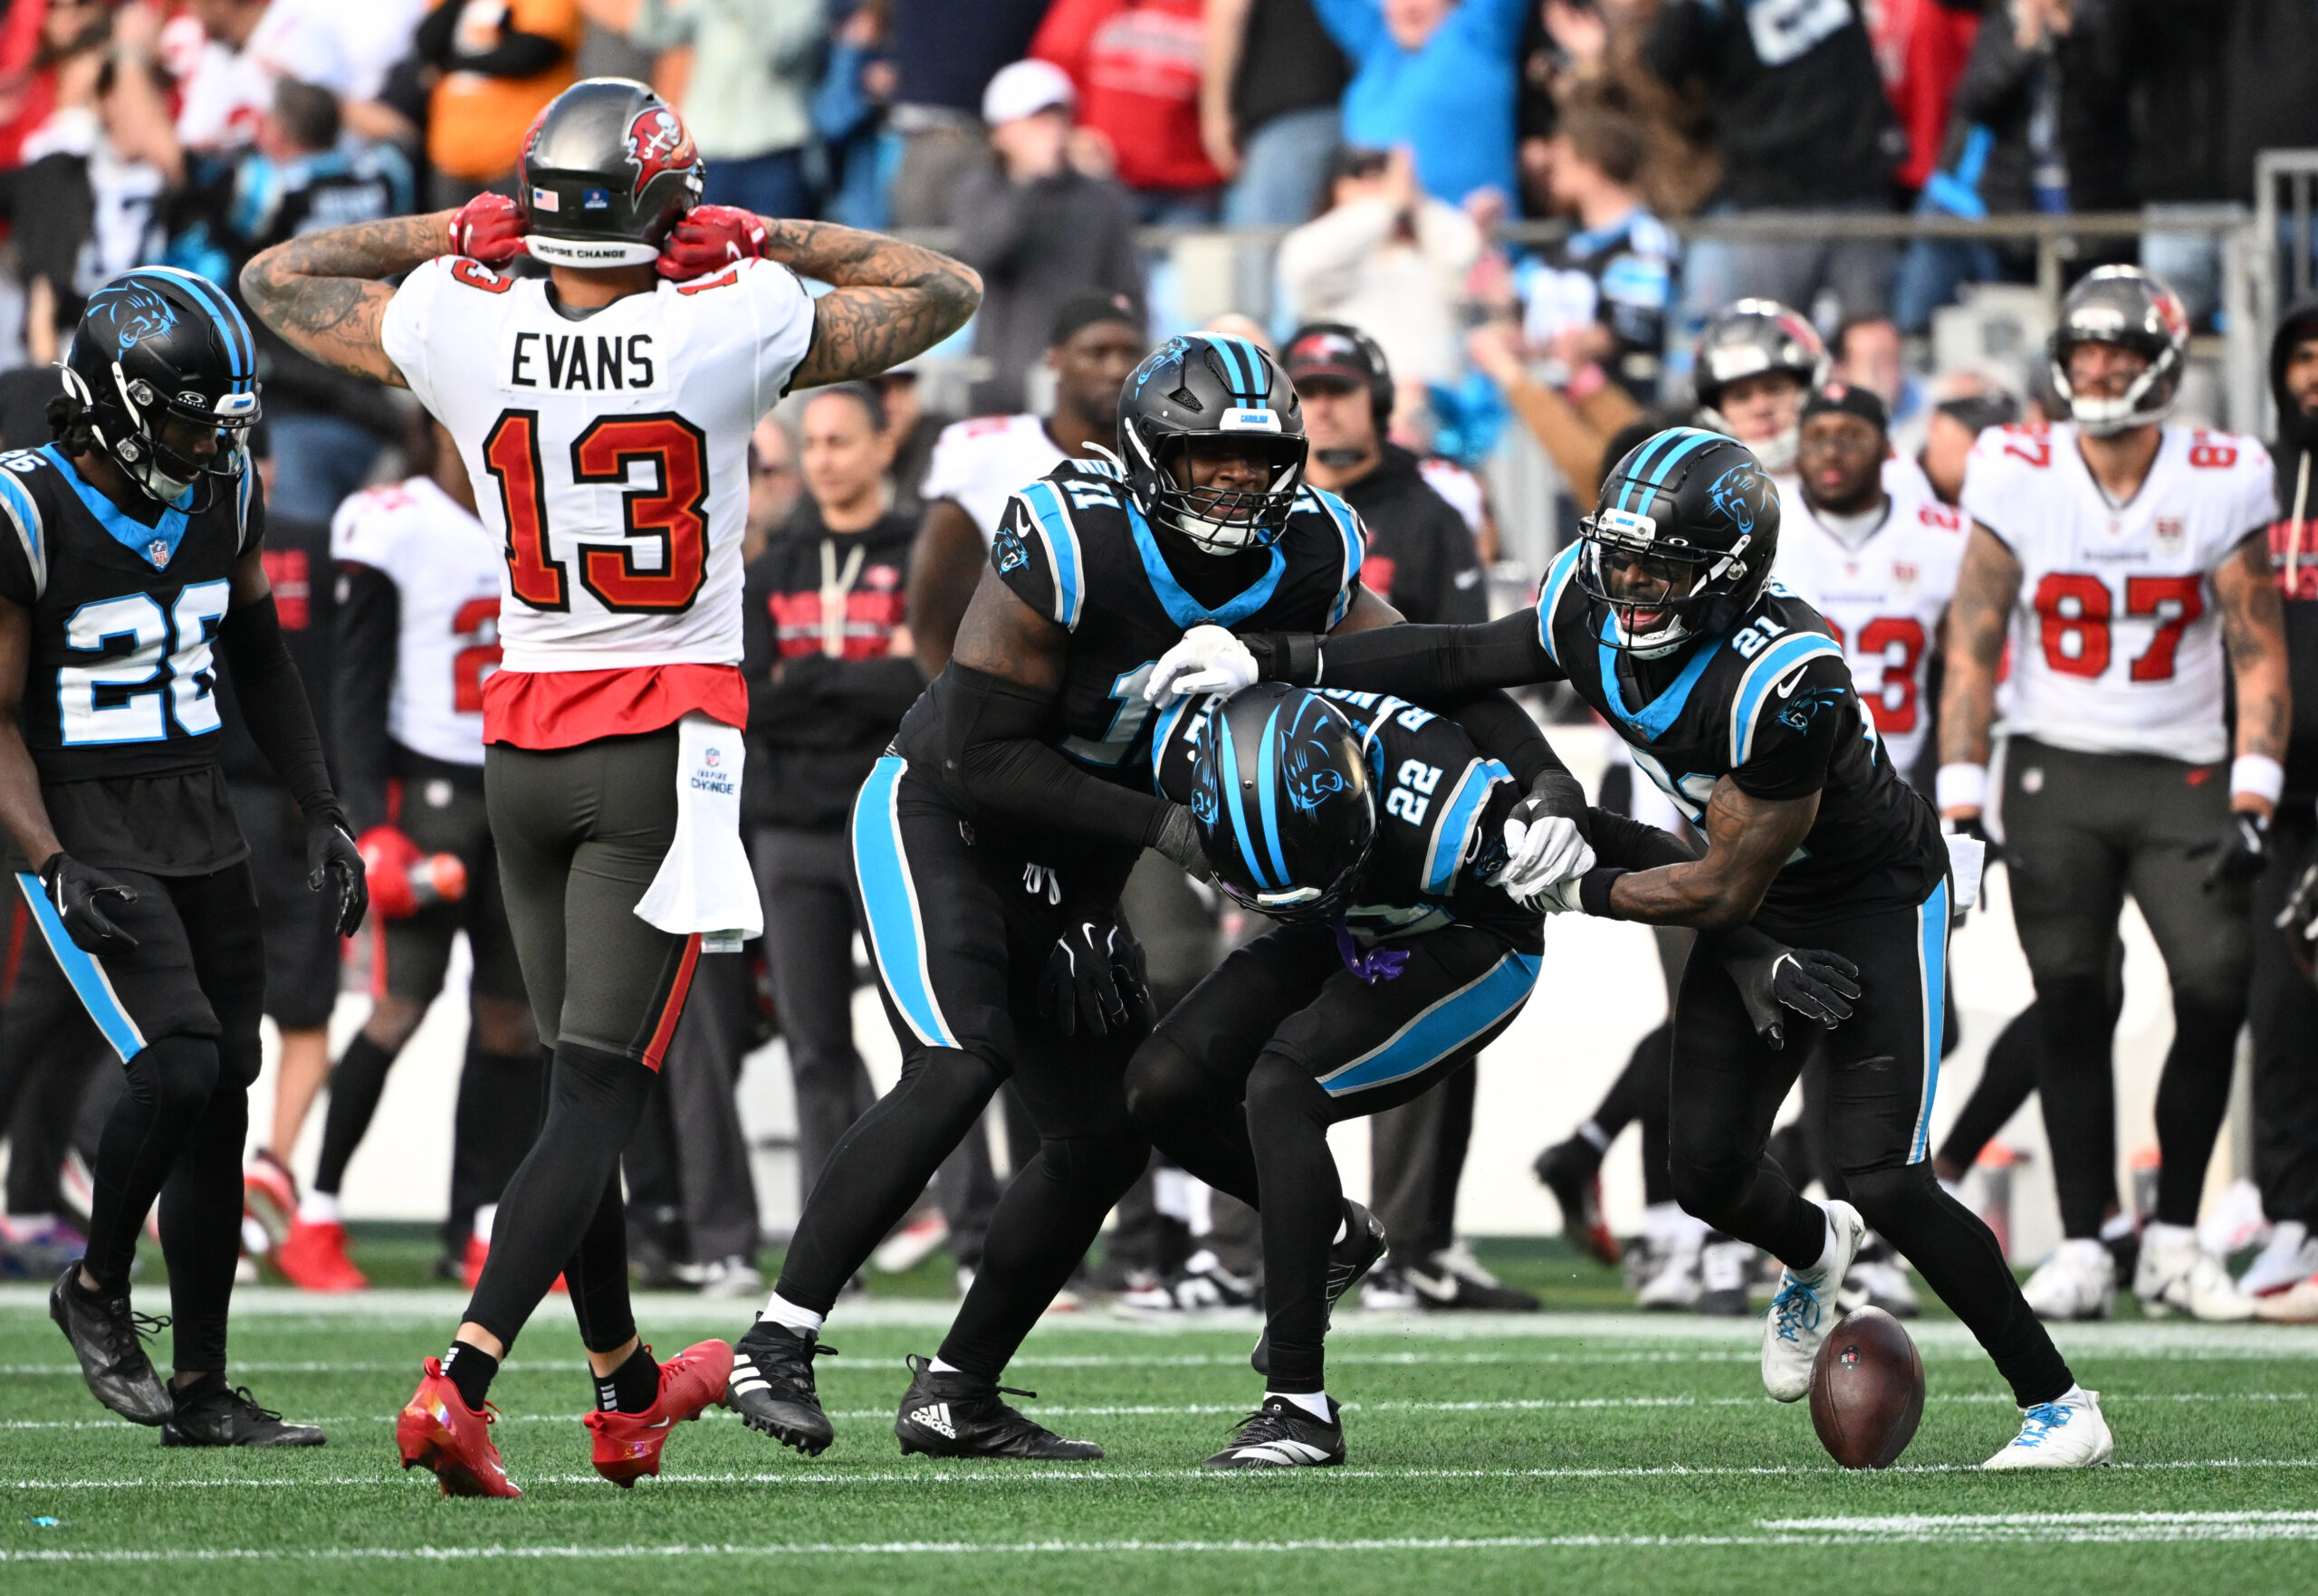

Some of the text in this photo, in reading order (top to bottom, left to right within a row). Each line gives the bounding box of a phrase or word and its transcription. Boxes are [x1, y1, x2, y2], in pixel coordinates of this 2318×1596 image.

[451, 259, 514, 294] 3
[577, 249, 626, 259] CHANGE
[512, 331, 654, 390] EVANS
[177, 397, 206, 409] OAKLEY
[483, 408, 709, 614] 13
[1731, 615, 1789, 660] 21
[2035, 573, 2204, 683] 87
[56, 578, 231, 747] 26
[1822, 615, 1925, 735] 3
[1058, 660, 1159, 769] 1
[691, 777, 734, 795] CHANGE
[1385, 758, 1444, 827] 22
[910, 1410, 956, 1439] adidas
